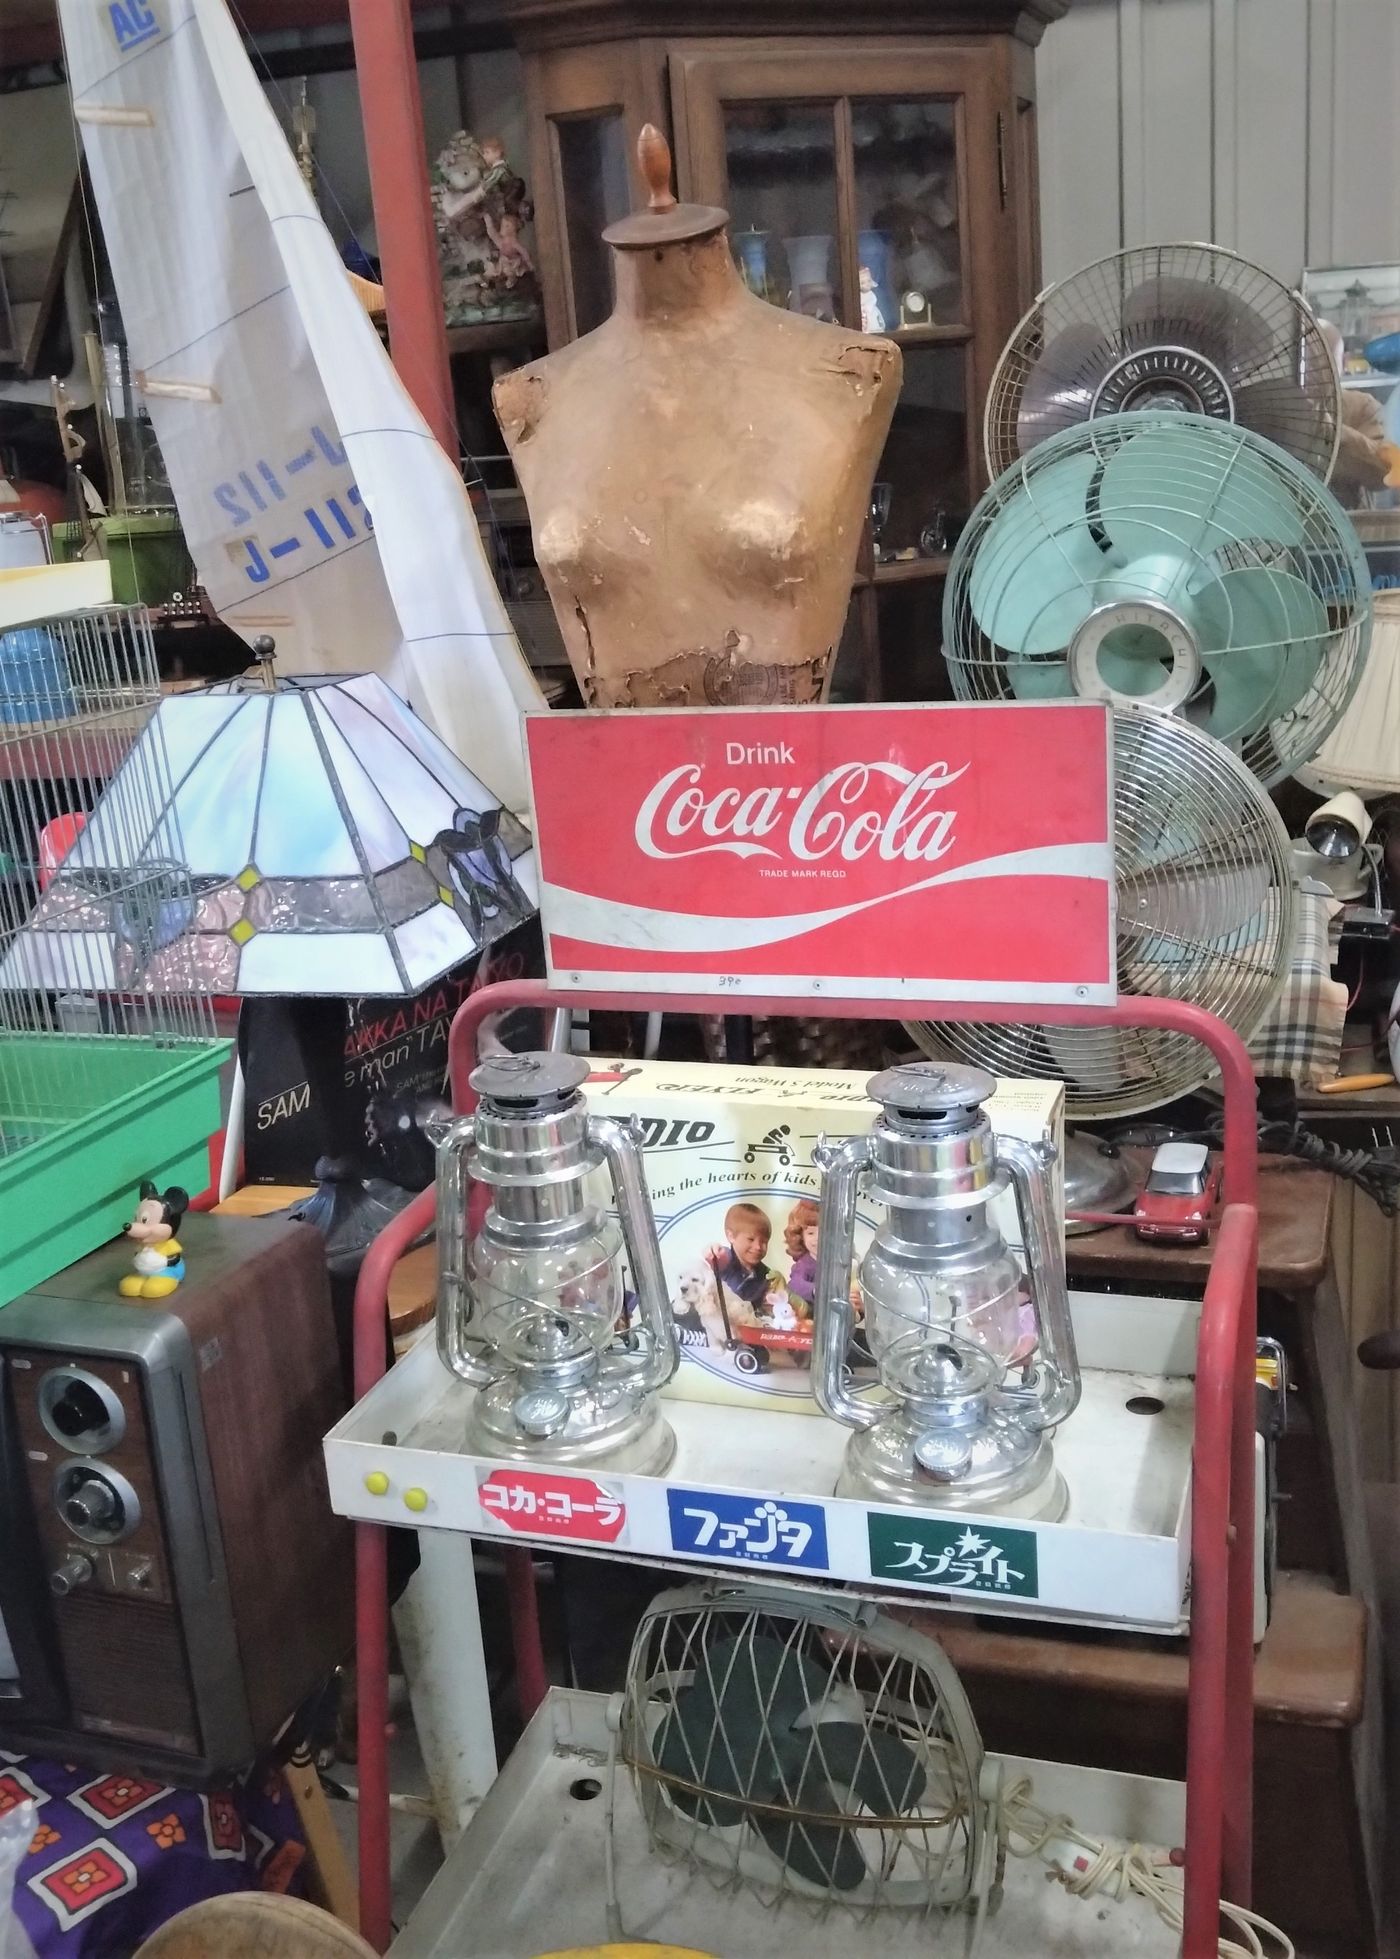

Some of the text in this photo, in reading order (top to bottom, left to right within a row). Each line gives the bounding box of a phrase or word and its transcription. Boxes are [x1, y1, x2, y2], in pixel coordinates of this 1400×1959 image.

[726, 742, 796, 765] Drink
[635, 761, 971, 860] Coca-Cola
[759, 869, 789, 878] TRADE
[791, 869, 818, 878] MARK
[413, 991, 447, 1027] NA
[735, 1077, 786, 1087] Wagon
[257, 1082, 310, 1130] SAM
[679, 1177, 702, 1190] the
[707, 1171, 757, 1184] hearts
[762, 1171, 781, 1183] of
[784, 1171, 817, 1186] kids
[483, 1484, 622, 1526] コカ・コーラ
[885, 1540, 1025, 1586] スプライト
